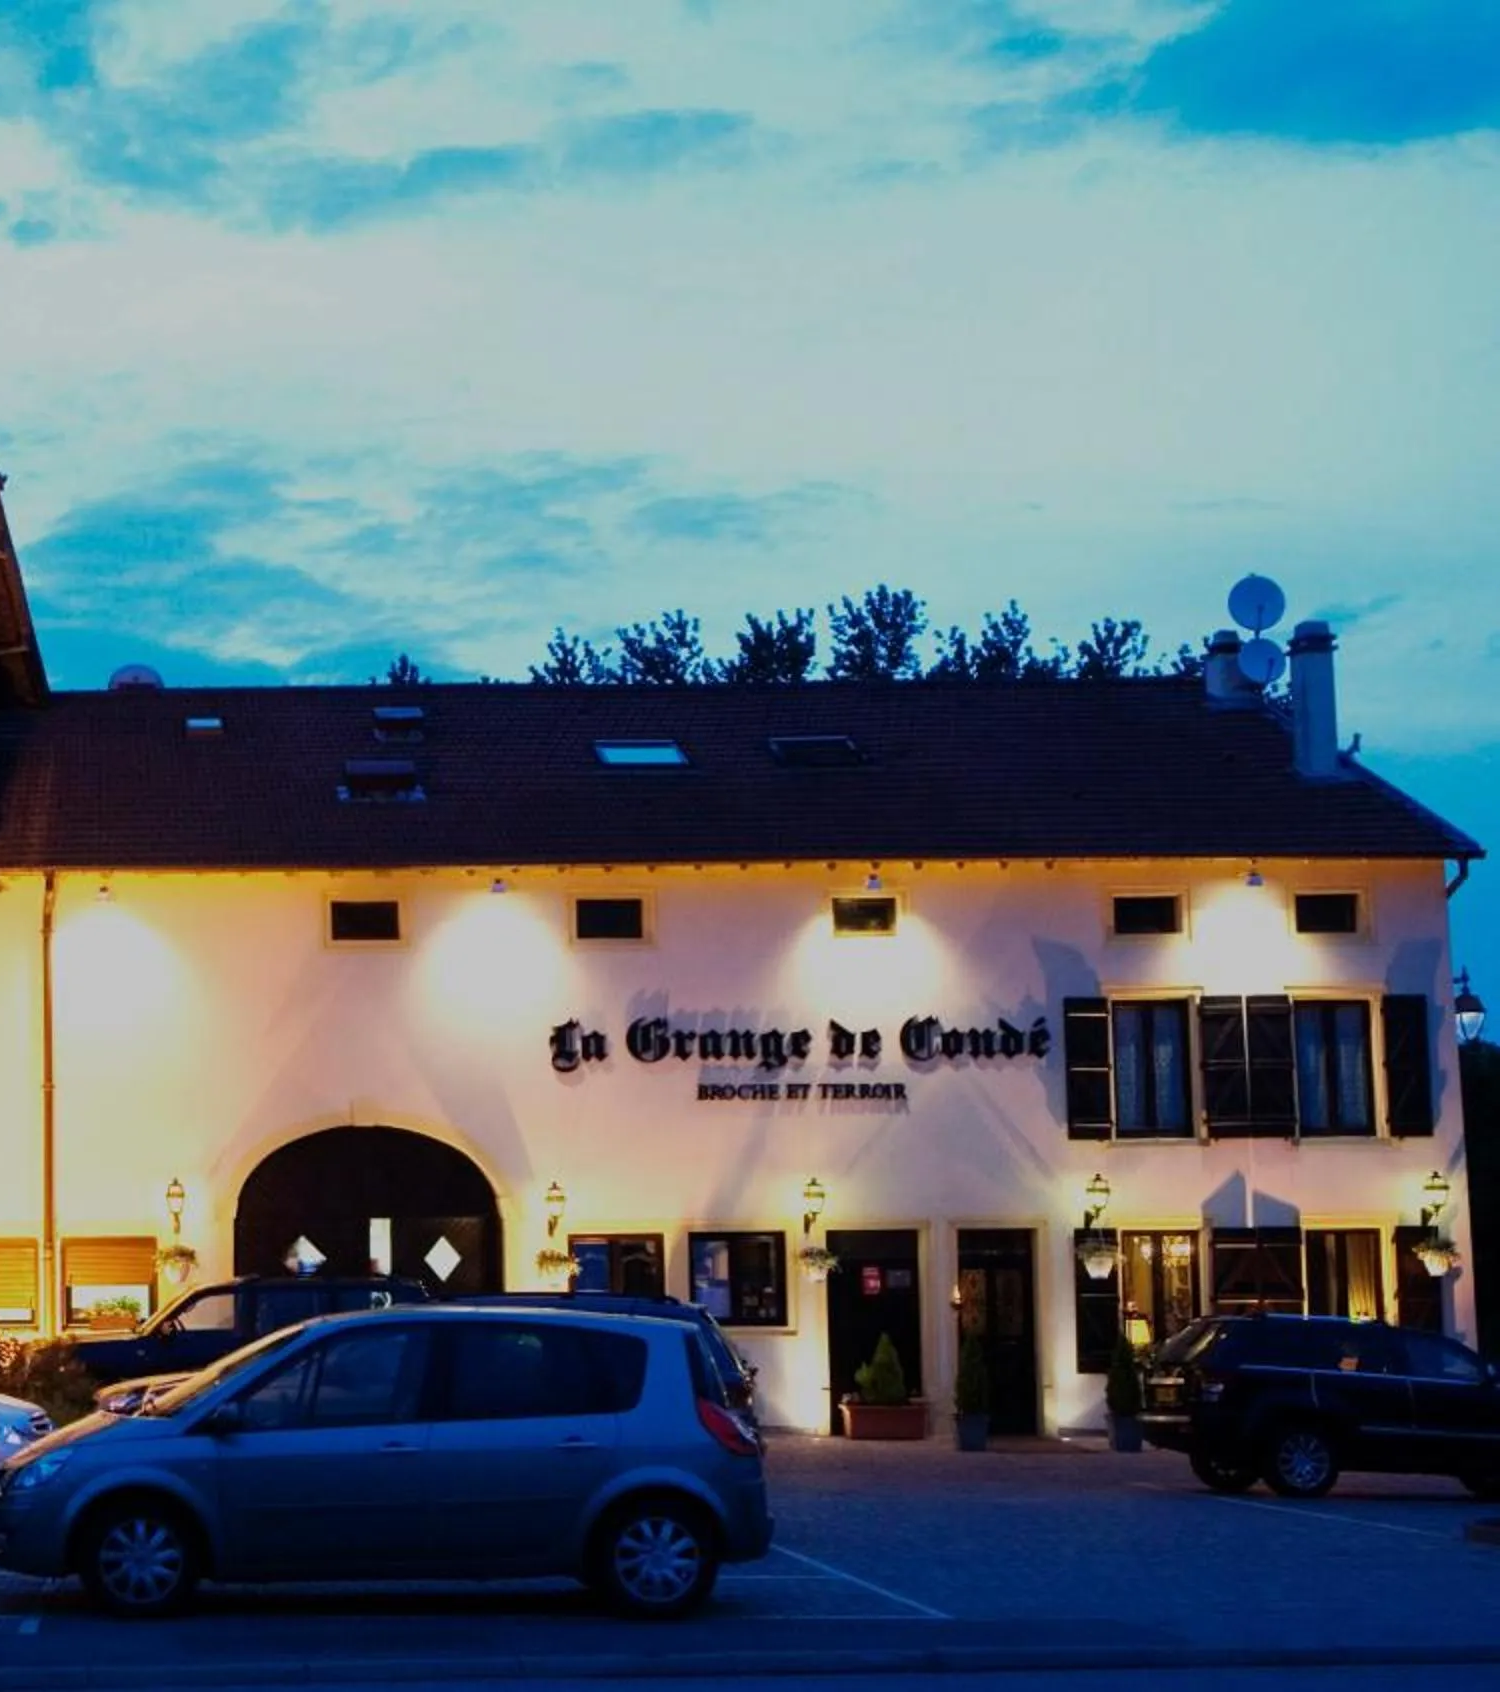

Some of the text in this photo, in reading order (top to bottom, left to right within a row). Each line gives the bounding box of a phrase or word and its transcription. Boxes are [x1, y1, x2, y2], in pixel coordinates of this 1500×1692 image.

[549, 1015, 1051, 1072] La Grange de Condé
[697, 1083, 908, 1100] BROCHE ET TERROIR
